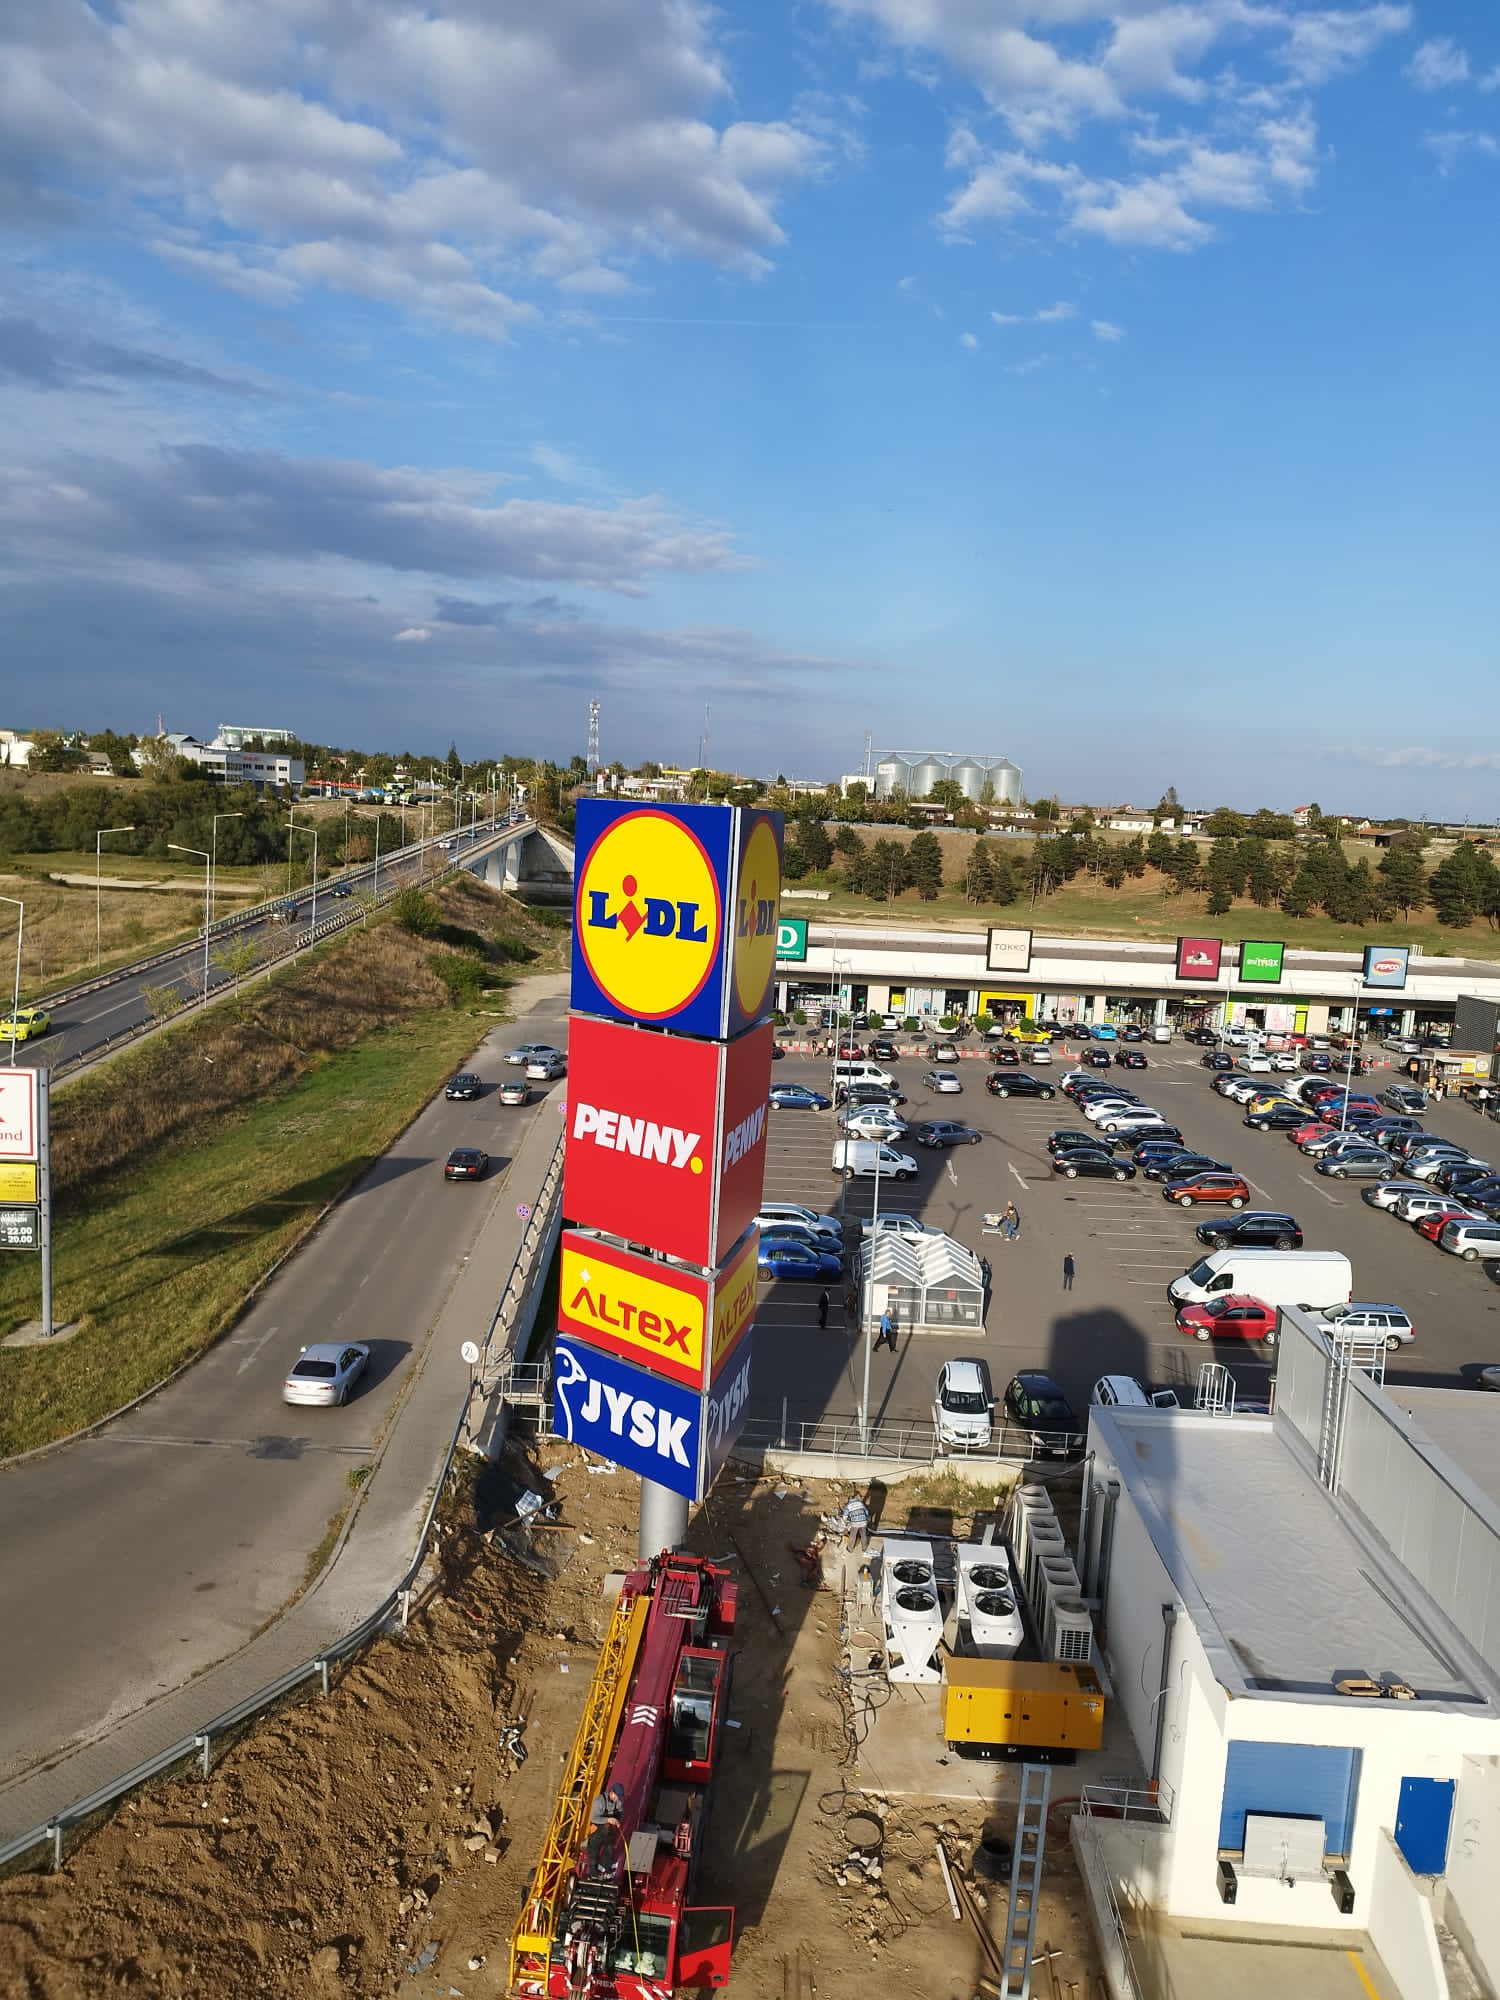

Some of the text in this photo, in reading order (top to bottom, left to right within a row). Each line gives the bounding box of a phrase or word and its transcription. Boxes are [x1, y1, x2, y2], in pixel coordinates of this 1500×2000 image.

[588, 874, 708, 943] LIDL
[580, 1378, 692, 1469] JYSK
[714, 1354, 752, 1449] JYSK
